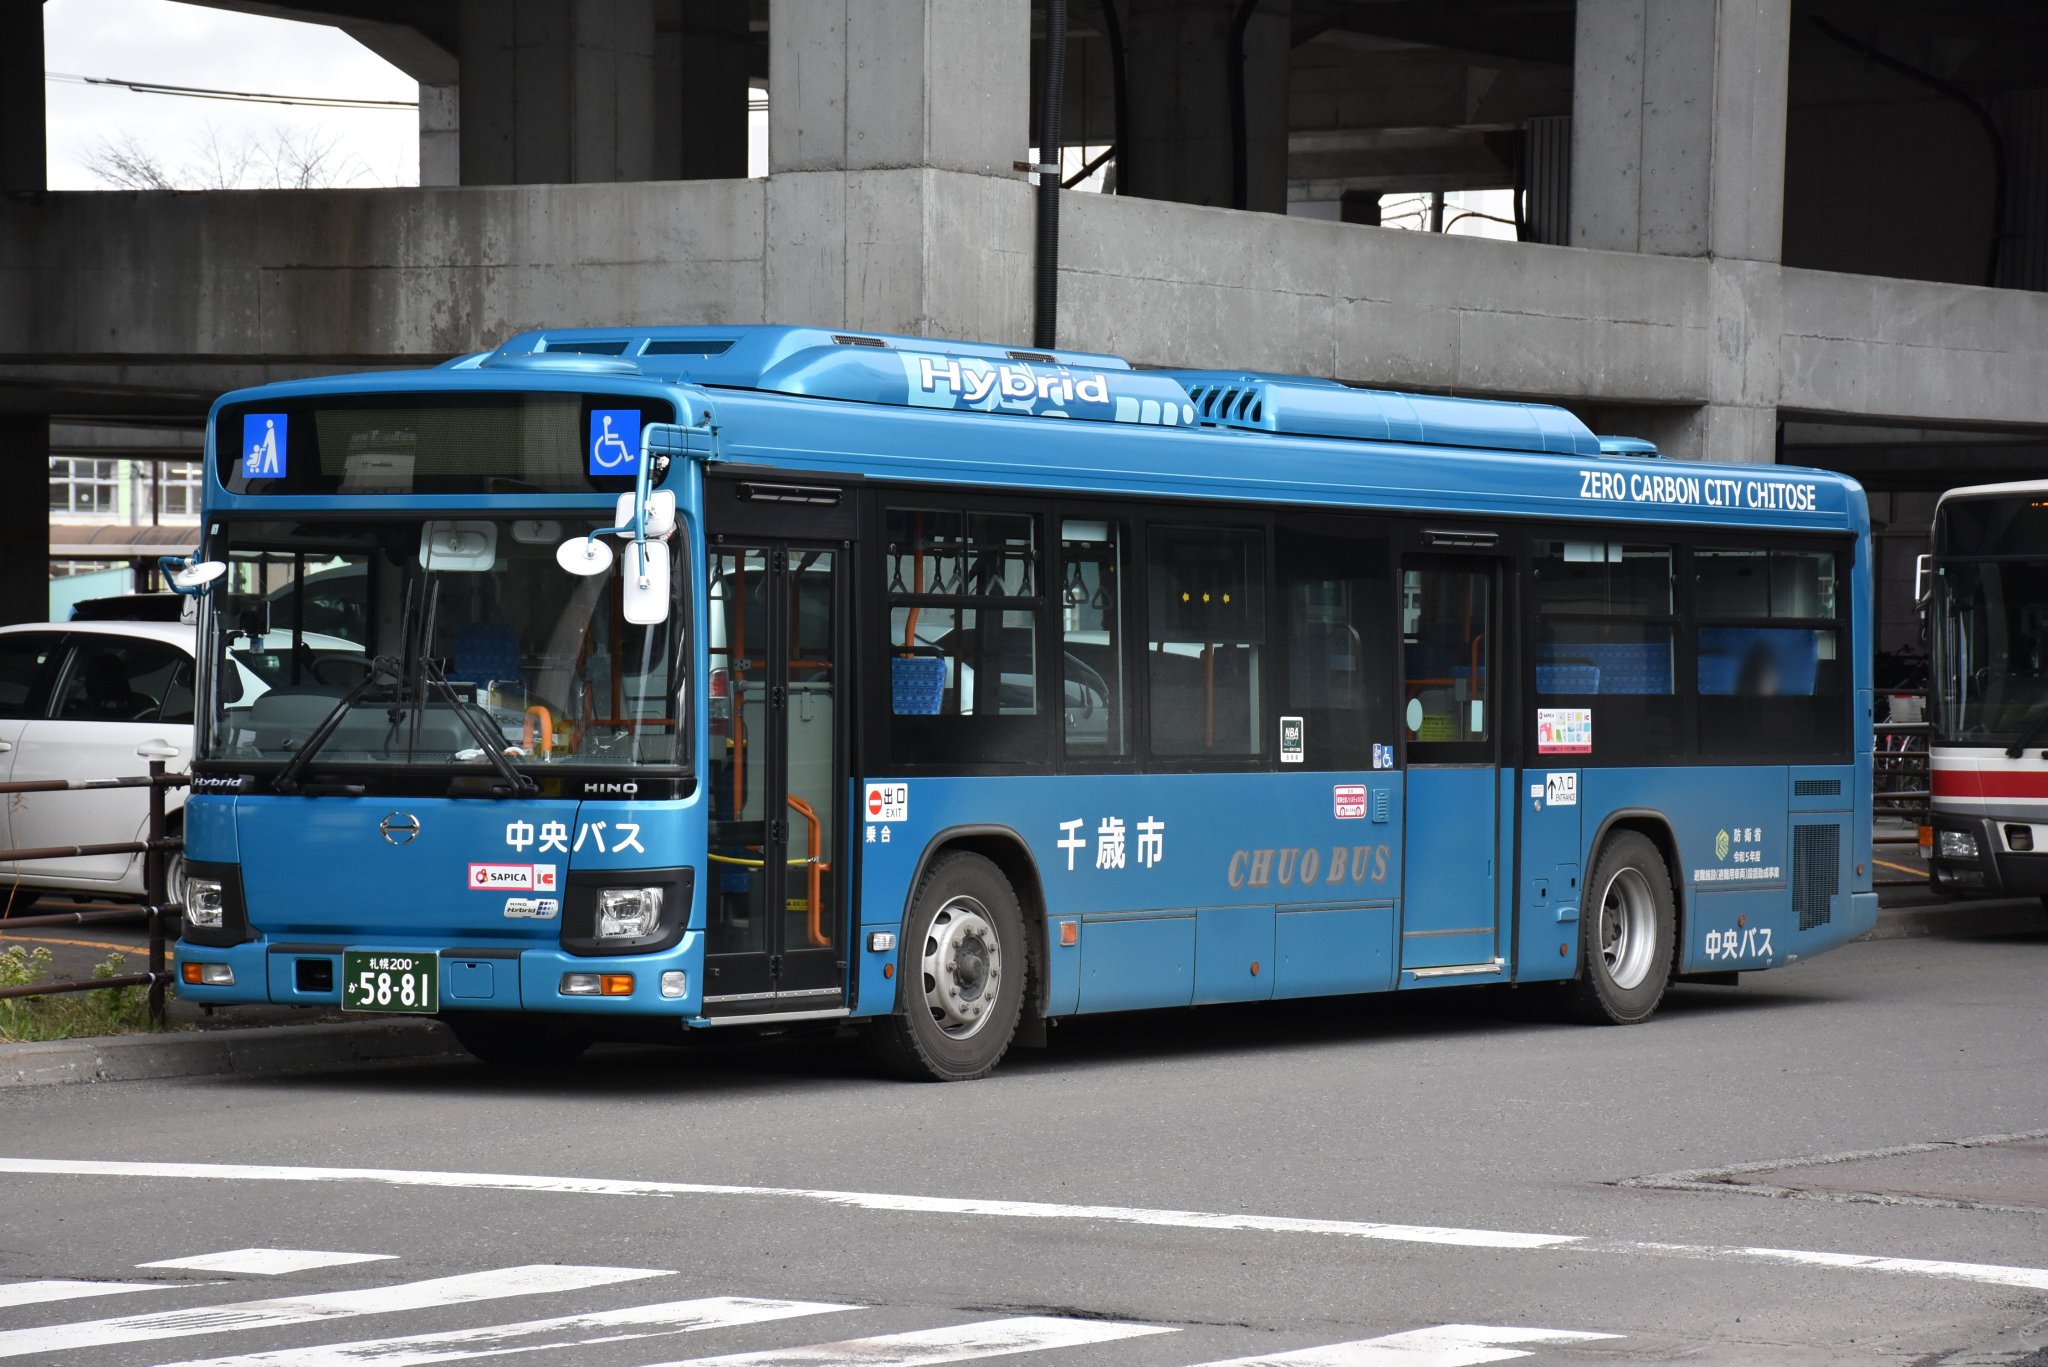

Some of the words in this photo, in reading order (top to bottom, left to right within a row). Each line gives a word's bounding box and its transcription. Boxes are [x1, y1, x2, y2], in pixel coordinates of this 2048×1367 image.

[919, 357, 1110, 404] Hybrid
[1579, 470, 1626, 500] ZERO
[1630, 474, 1700, 505] CARBON
[1704, 479, 1742, 506] CITY
[1746, 481, 1816, 511] CHITOSE
[1284, 727, 1299, 738] NBA
[194, 777, 243, 787] Hybrid
[584, 783, 638, 793] HINO
[1557, 775, 1574, 791] 入口
[883, 787, 906, 805] 出口
[1555, 793, 1576, 802] ENTRANCE
[885, 807, 902, 818] EXIT
[506, 819, 645, 853] 中央バス
[865, 825, 891, 843] 乗合
[1056, 815, 1165, 871] 千歳市
[1733, 828, 1762, 843] 防衛省
[1227, 848, 1320, 888] CHUO
[1326, 844, 1390, 885] BUS
[490, 873, 527, 882] SAPICA
[1705, 927, 1773, 960] 中央バス
[360, 972, 428, 1007] 58-81
